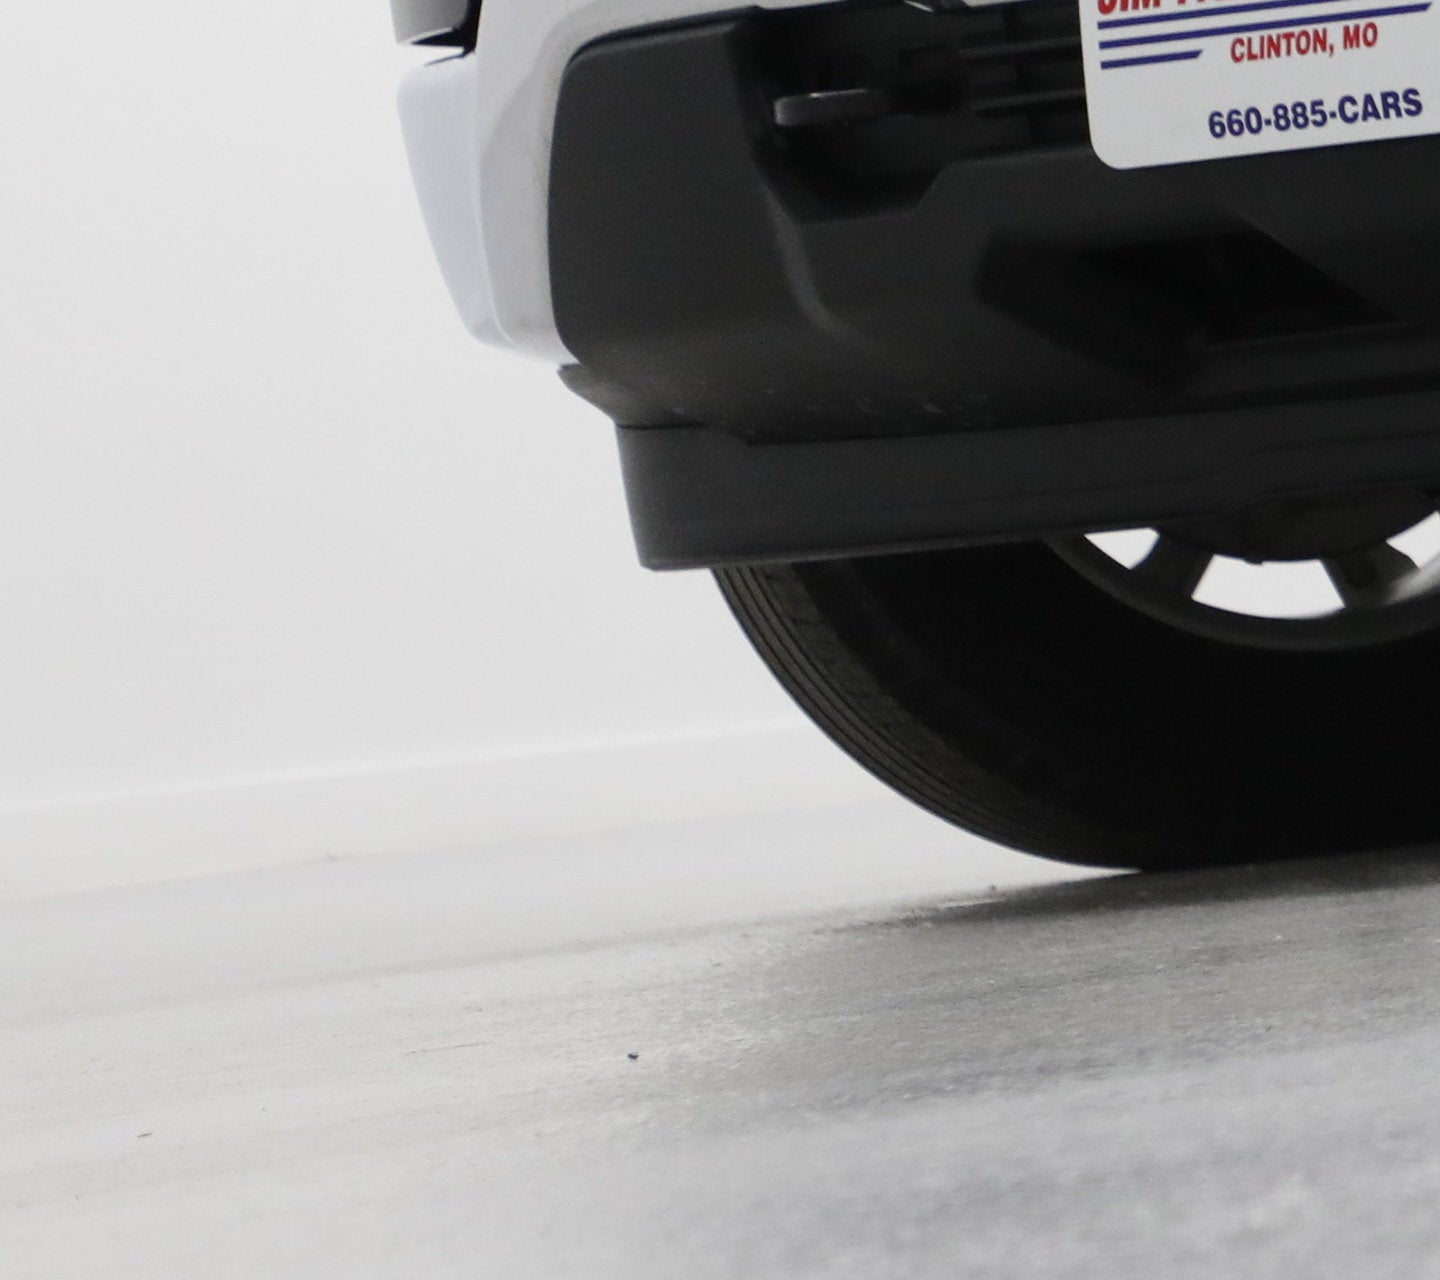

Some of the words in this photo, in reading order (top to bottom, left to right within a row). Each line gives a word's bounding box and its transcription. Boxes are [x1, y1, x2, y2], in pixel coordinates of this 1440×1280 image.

[1230, 28, 1335, 64] CLINTON,
[1342, 22, 1379, 49] MO
[1207, 87, 1424, 140] 660-885-CARS
